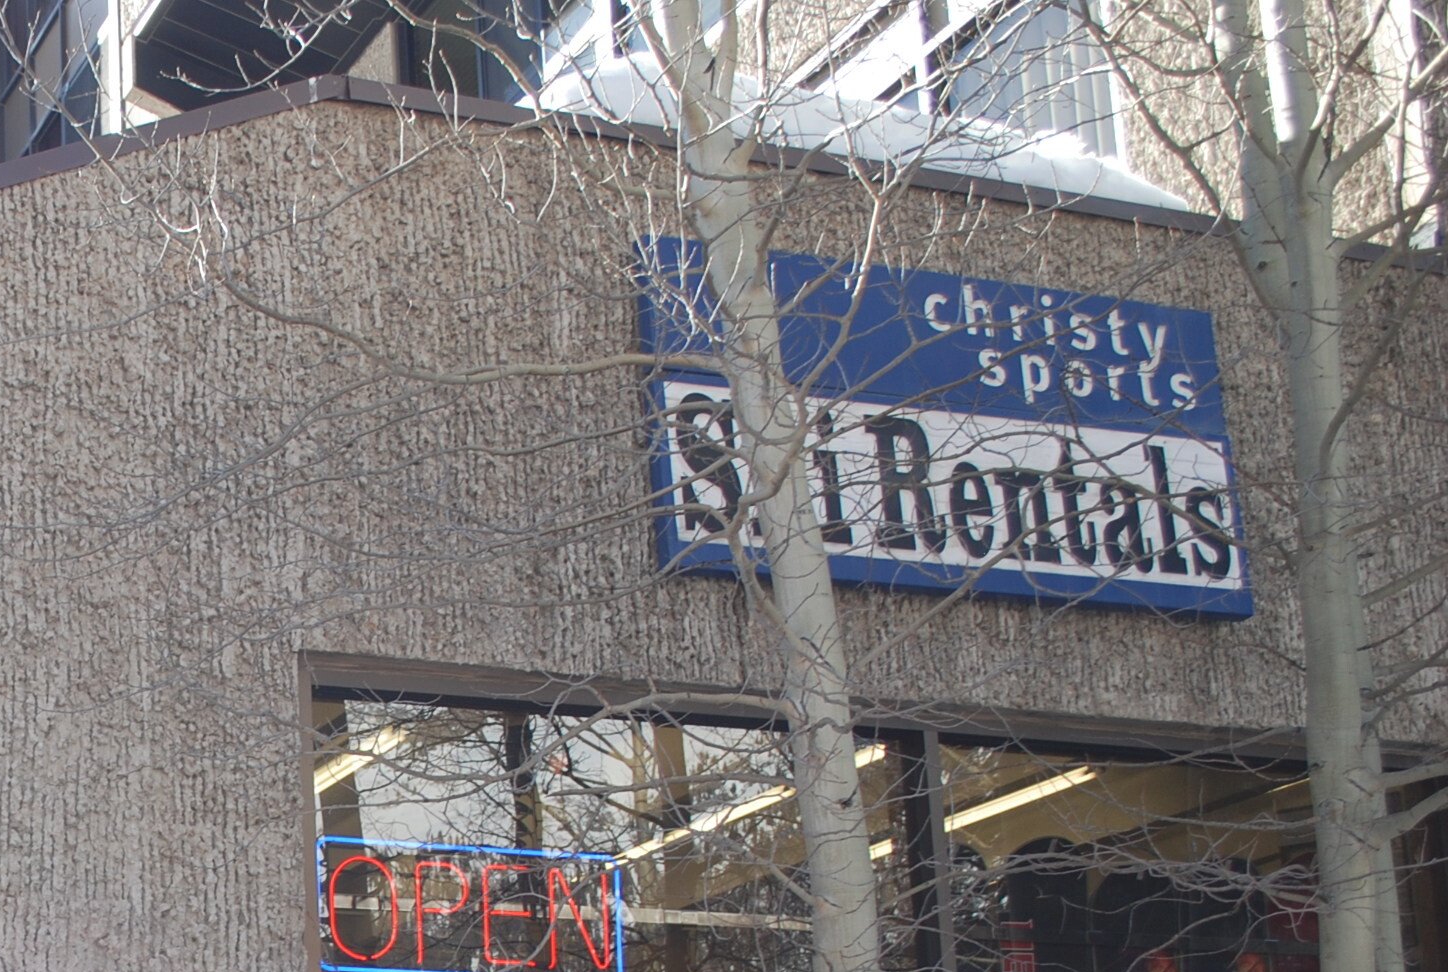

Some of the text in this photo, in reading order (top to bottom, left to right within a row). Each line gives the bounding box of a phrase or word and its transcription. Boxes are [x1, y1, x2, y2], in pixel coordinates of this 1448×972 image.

[924, 283, 1166, 372] christy
[978, 348, 1196, 411] sports
[863, 413, 1231, 580] Rentals
[328, 855, 612, 970] OPEN
